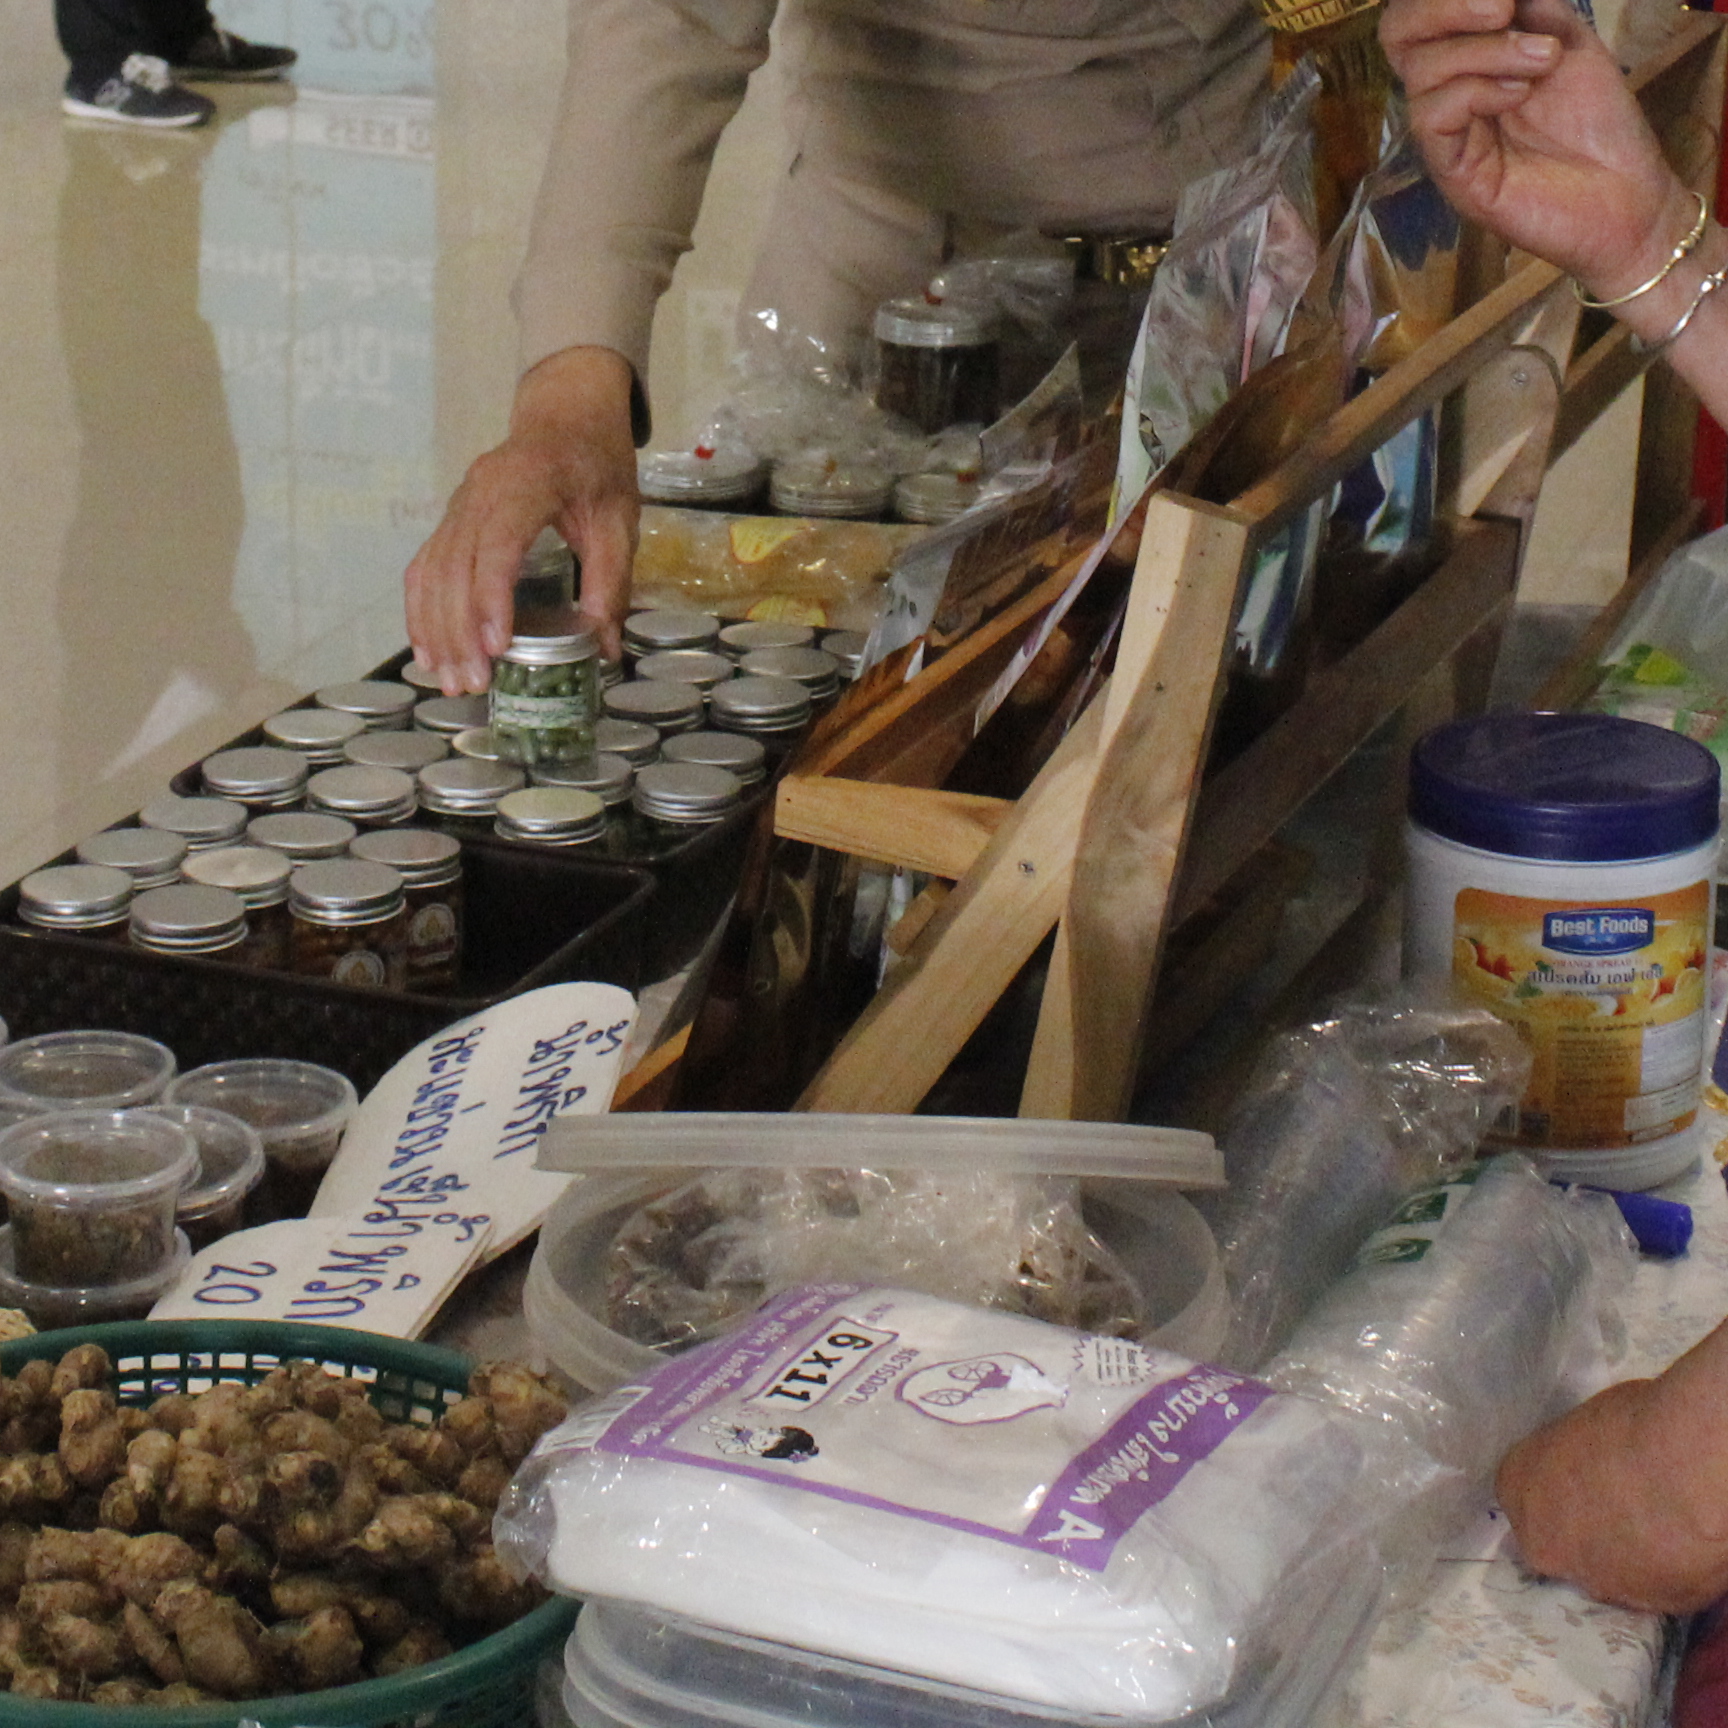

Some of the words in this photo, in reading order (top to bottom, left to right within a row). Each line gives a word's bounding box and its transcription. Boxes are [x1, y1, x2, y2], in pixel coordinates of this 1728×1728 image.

[1550, 917, 1596, 938] Best
[1599, 915, 1649, 935] Foods
[1037, 1508, 1105, 1541] A
